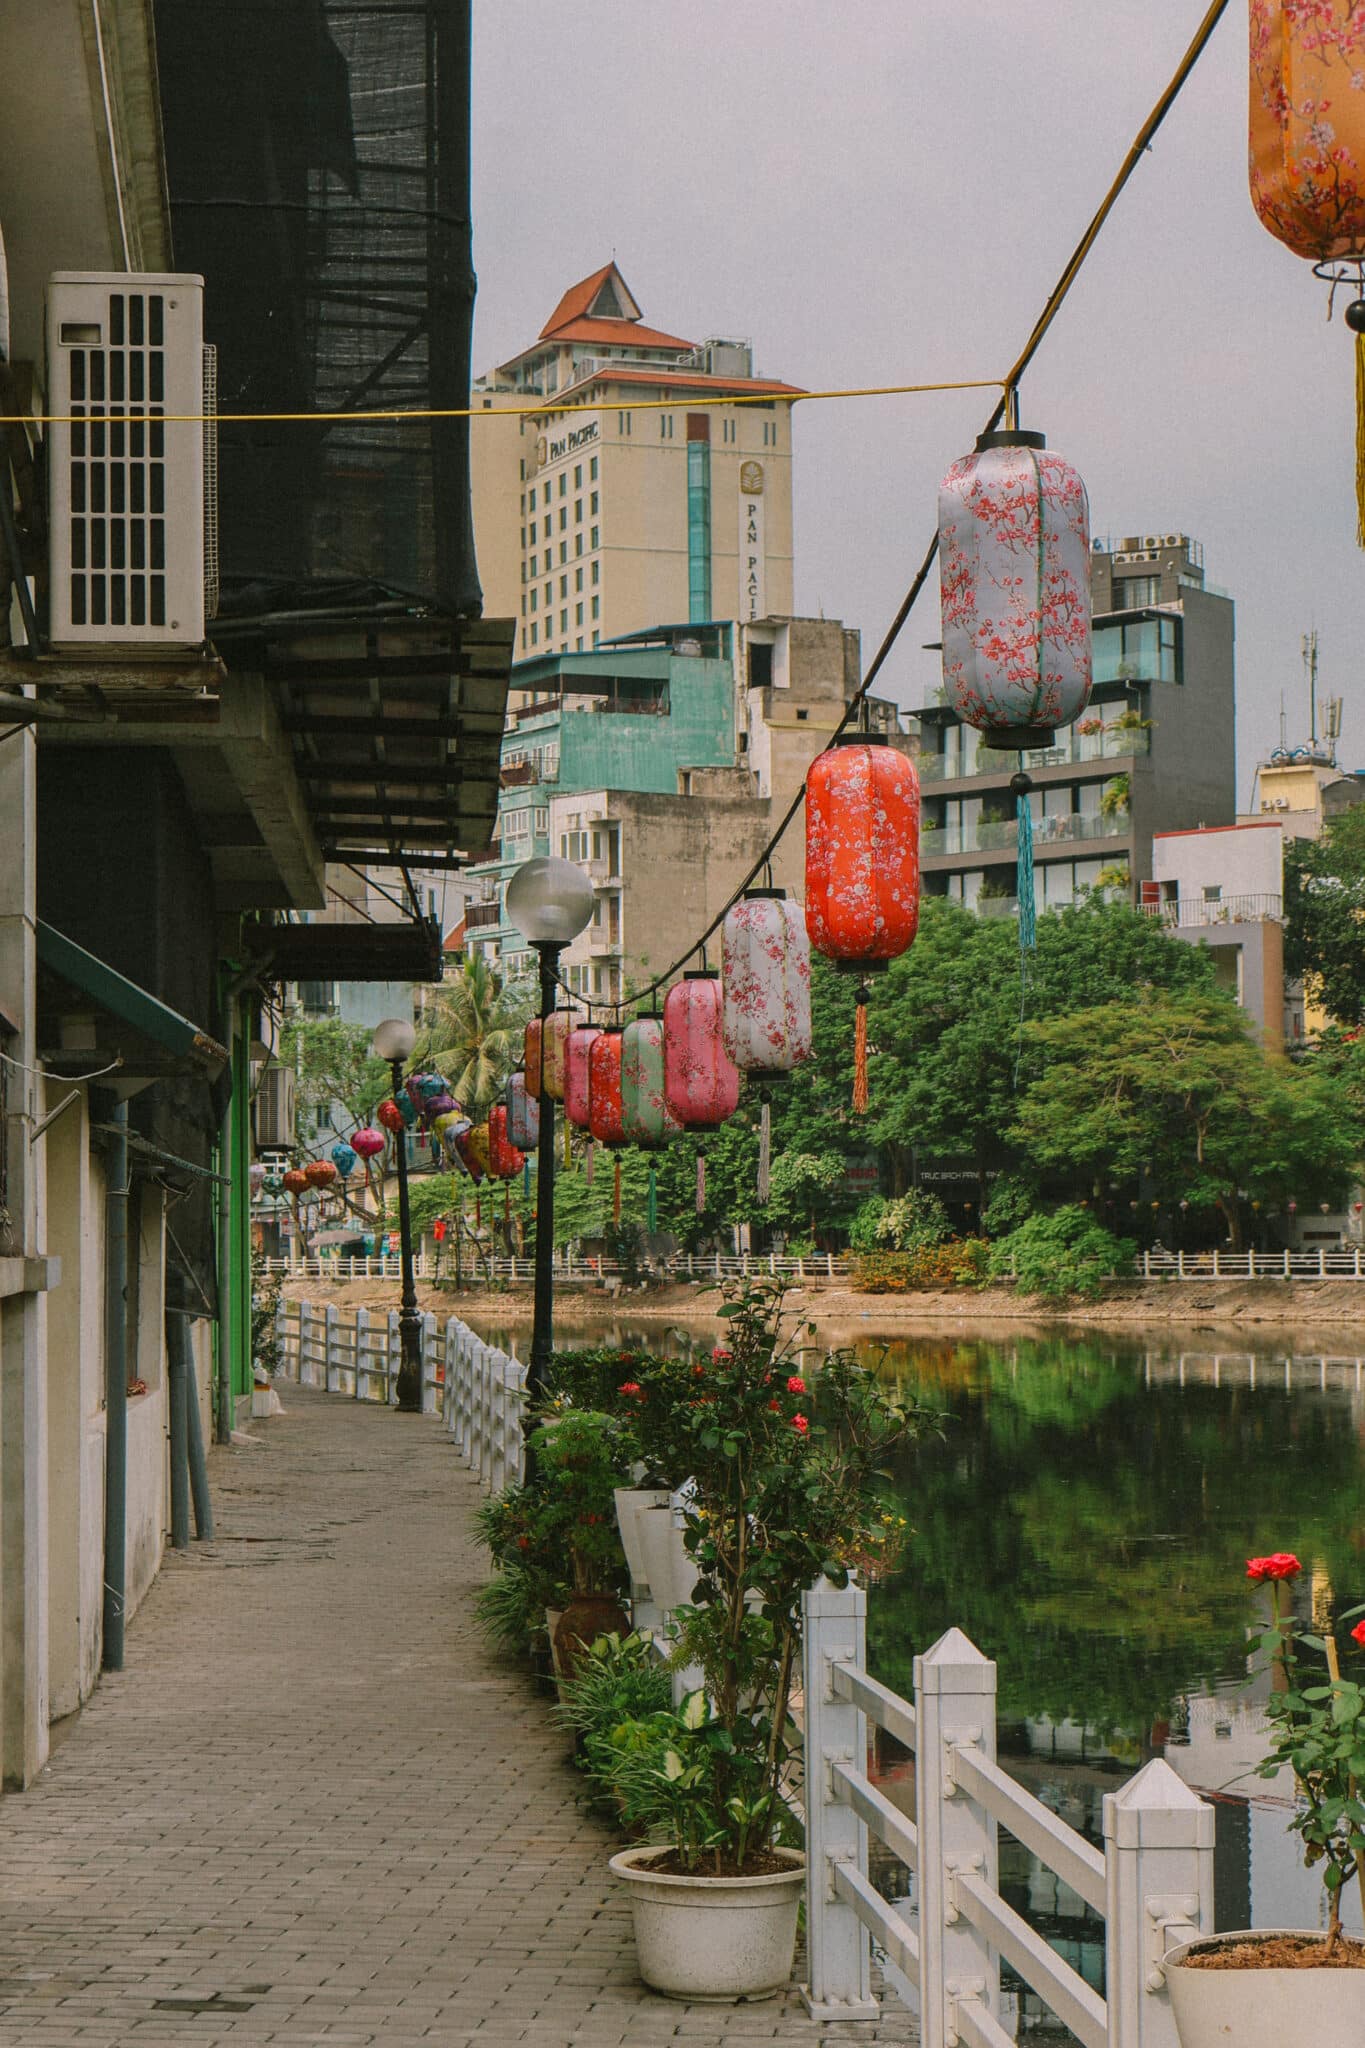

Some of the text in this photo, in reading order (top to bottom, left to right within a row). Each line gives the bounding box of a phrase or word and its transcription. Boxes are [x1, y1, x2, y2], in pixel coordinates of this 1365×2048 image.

[550, 421, 598, 460] PAN PACIFIC
[747, 504, 757, 544] PAN
